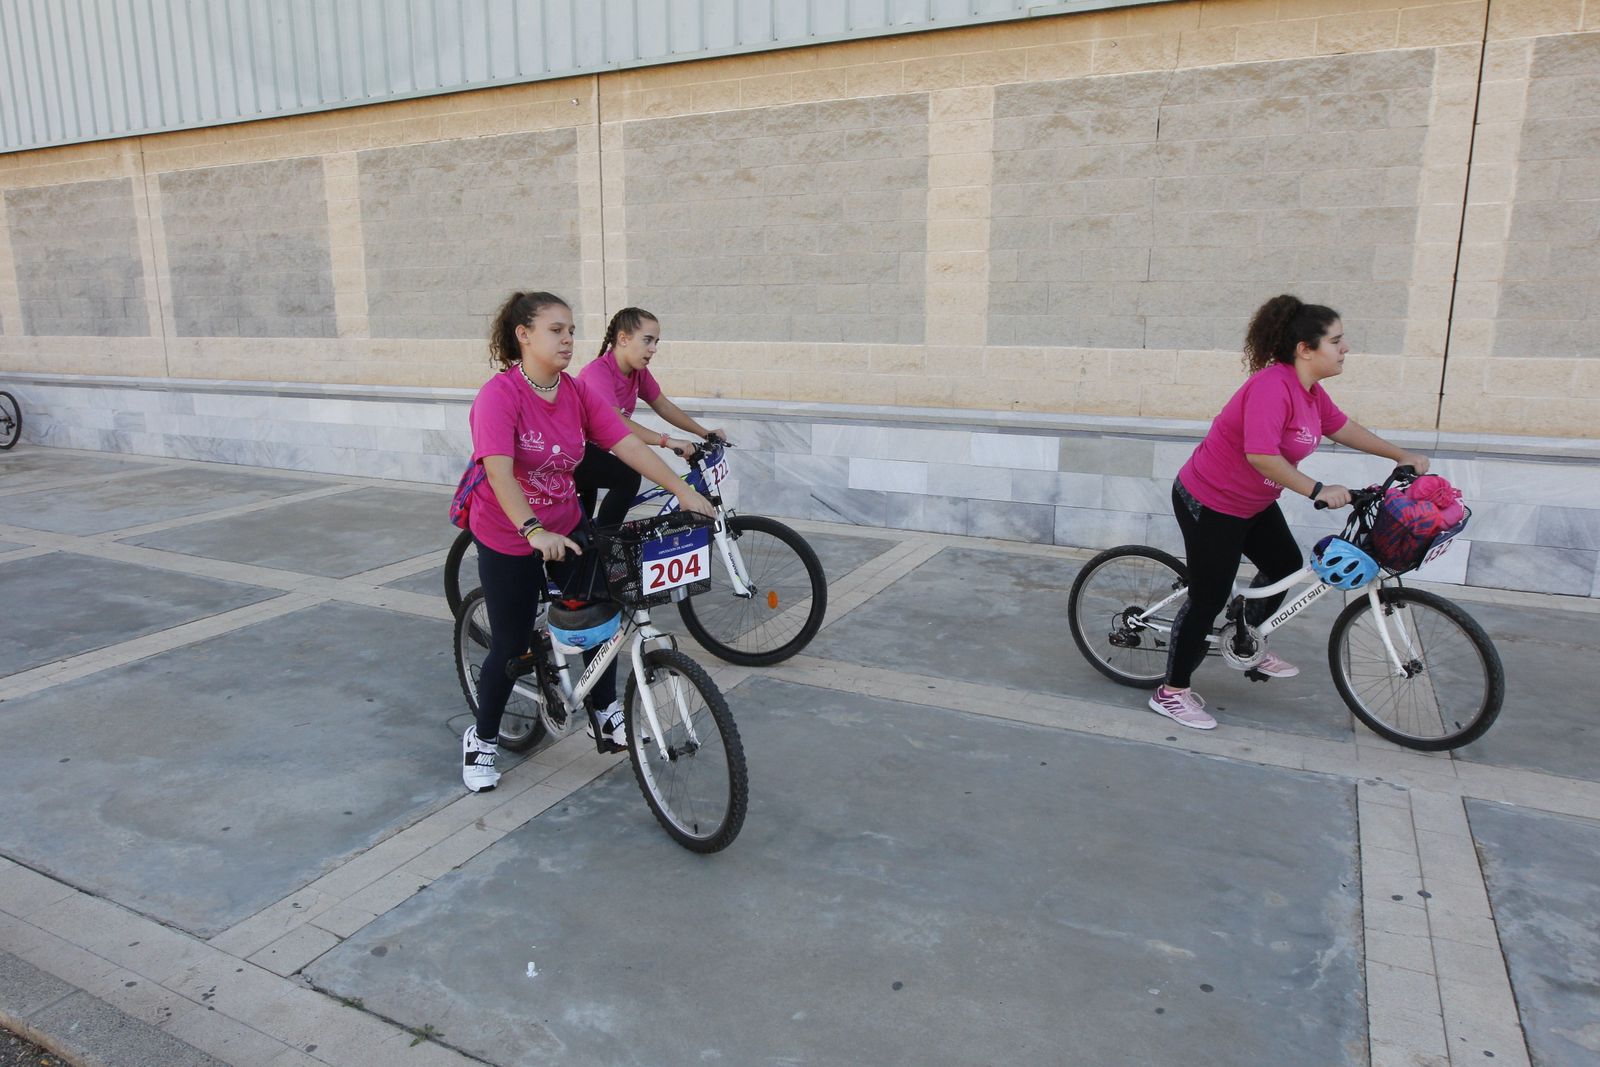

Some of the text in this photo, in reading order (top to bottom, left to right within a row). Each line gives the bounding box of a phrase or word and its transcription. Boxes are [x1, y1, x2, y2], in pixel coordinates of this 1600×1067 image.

[528, 497, 541, 505] DE
[1424, 539, 1453, 565] 432
[649, 553, 701, 590] 204
[1270, 583, 1327, 628] MOUNTAIN
[610, 711, 626, 728] NIK
